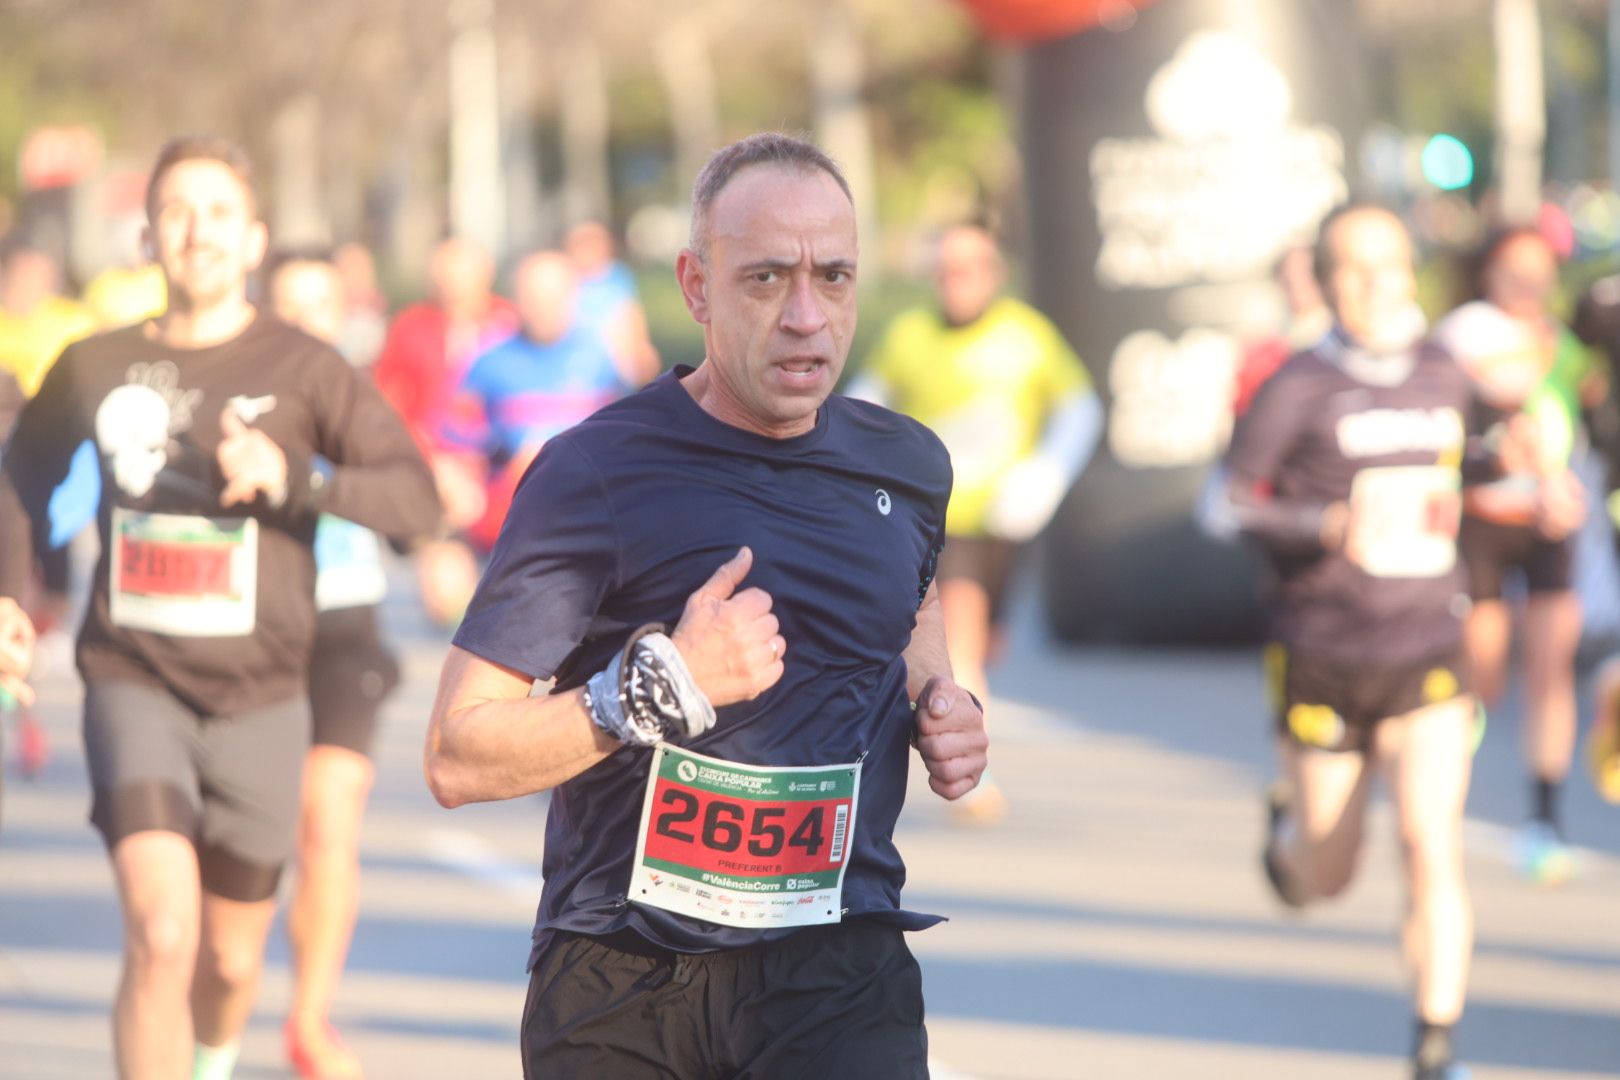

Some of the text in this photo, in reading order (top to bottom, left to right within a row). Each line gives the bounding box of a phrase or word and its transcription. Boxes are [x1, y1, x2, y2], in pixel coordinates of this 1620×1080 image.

[699, 771, 728, 783] CAIXA
[726, 777, 762, 789] POPULAR
[656, 788, 825, 857] 2654
[718, 860, 773, 873] PREFERENT
[702, 873, 780, 891] #ValènciaCorre
